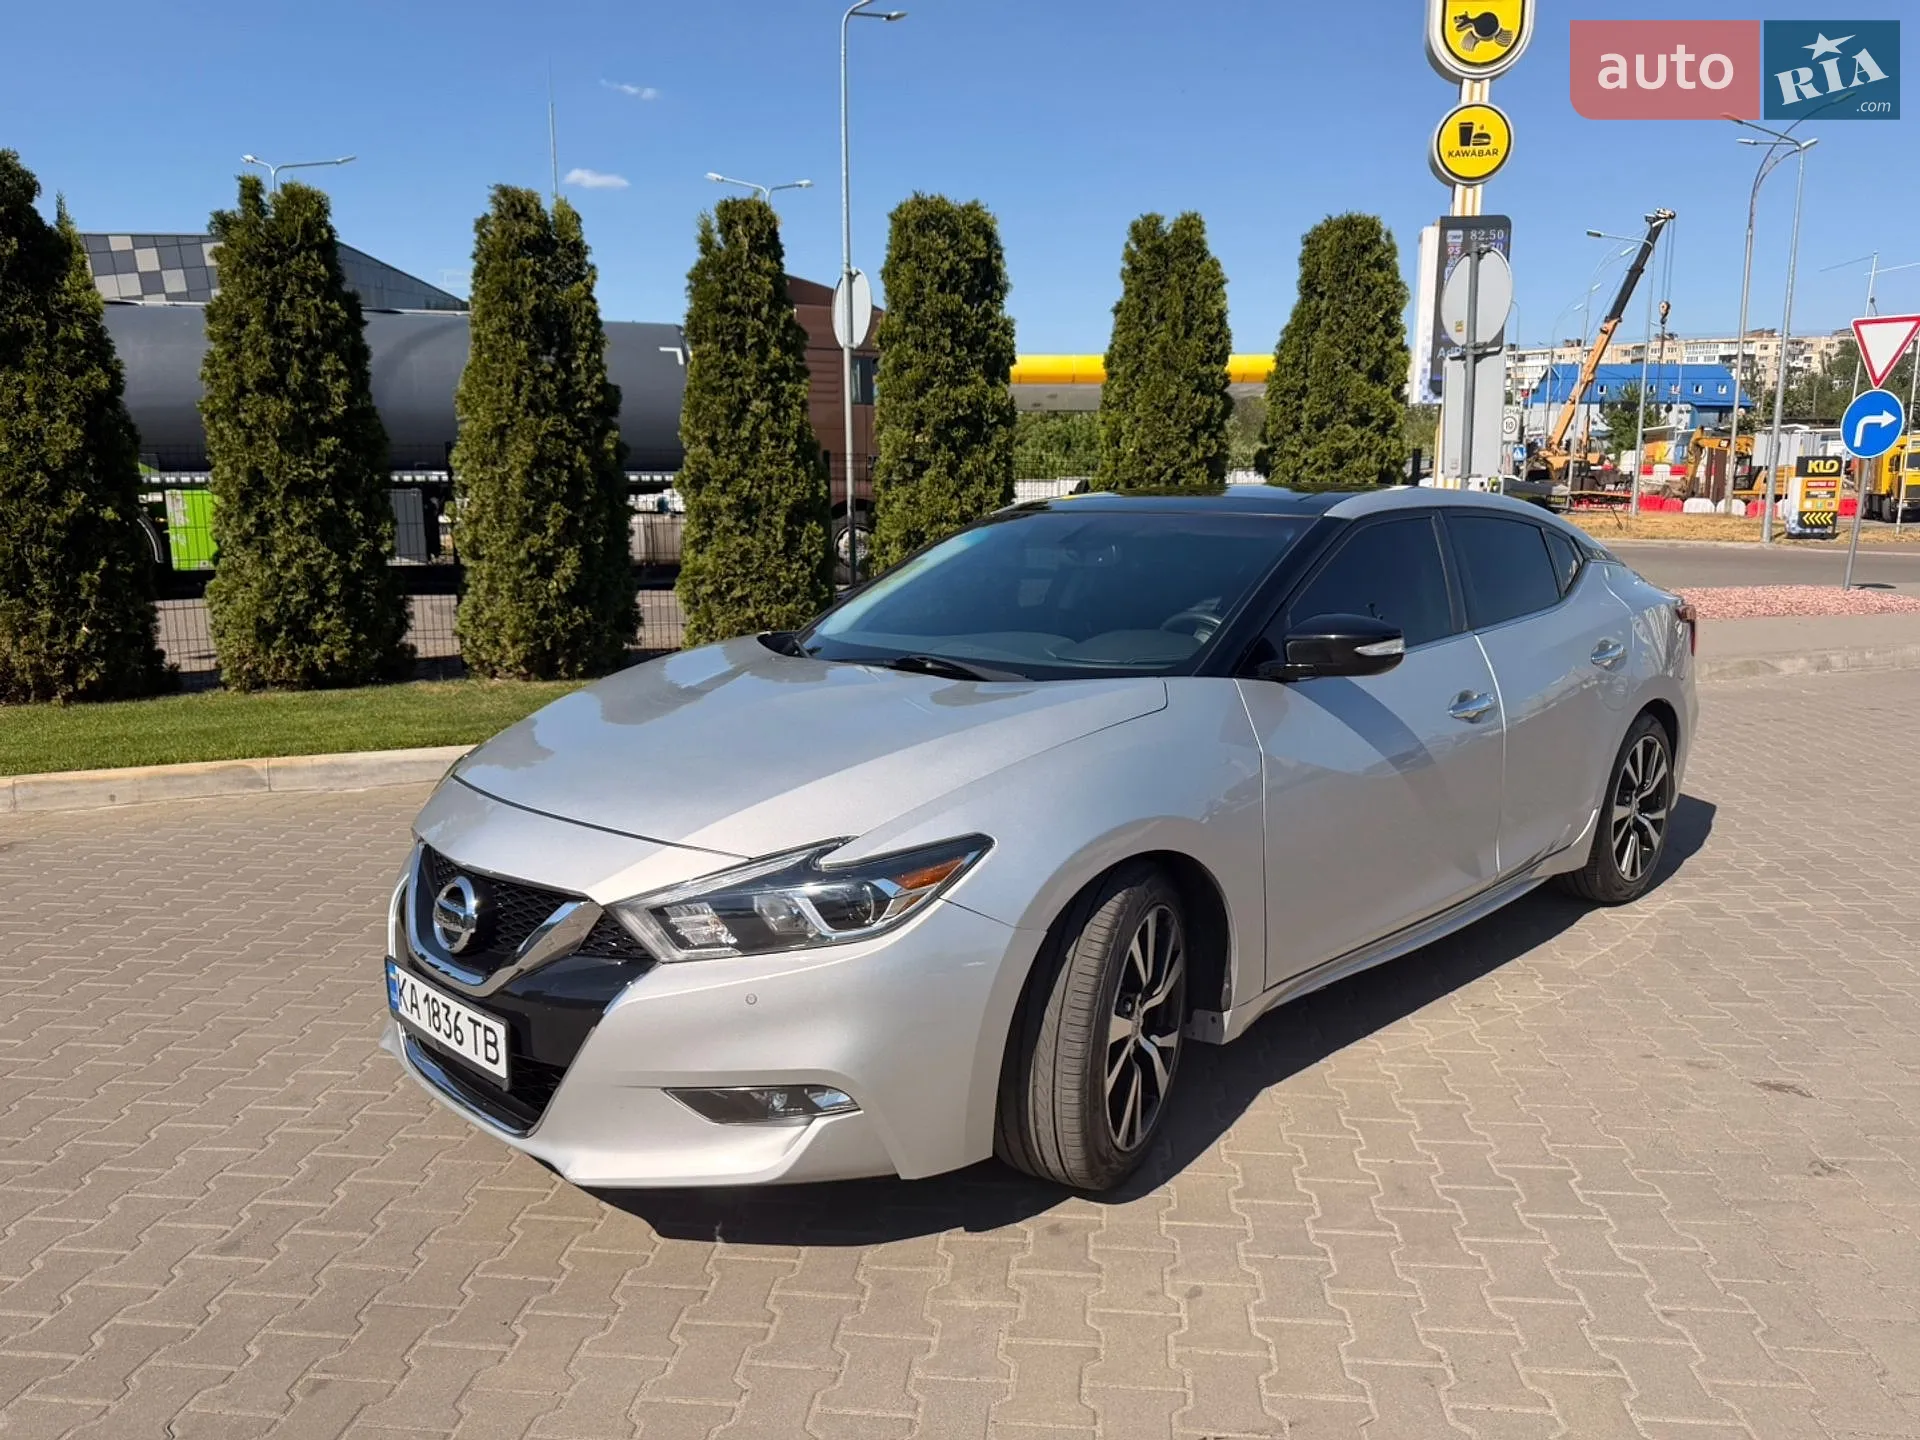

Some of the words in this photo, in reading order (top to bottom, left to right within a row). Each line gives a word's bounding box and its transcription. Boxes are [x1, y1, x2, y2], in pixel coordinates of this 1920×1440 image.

[1470, 229, 1504, 241] 82.50
[1807, 460, 1839, 473] KLO
[397, 972, 421, 1021] KA
[424, 993, 464, 1047] 1836
[467, 1015, 500, 1066] TB
